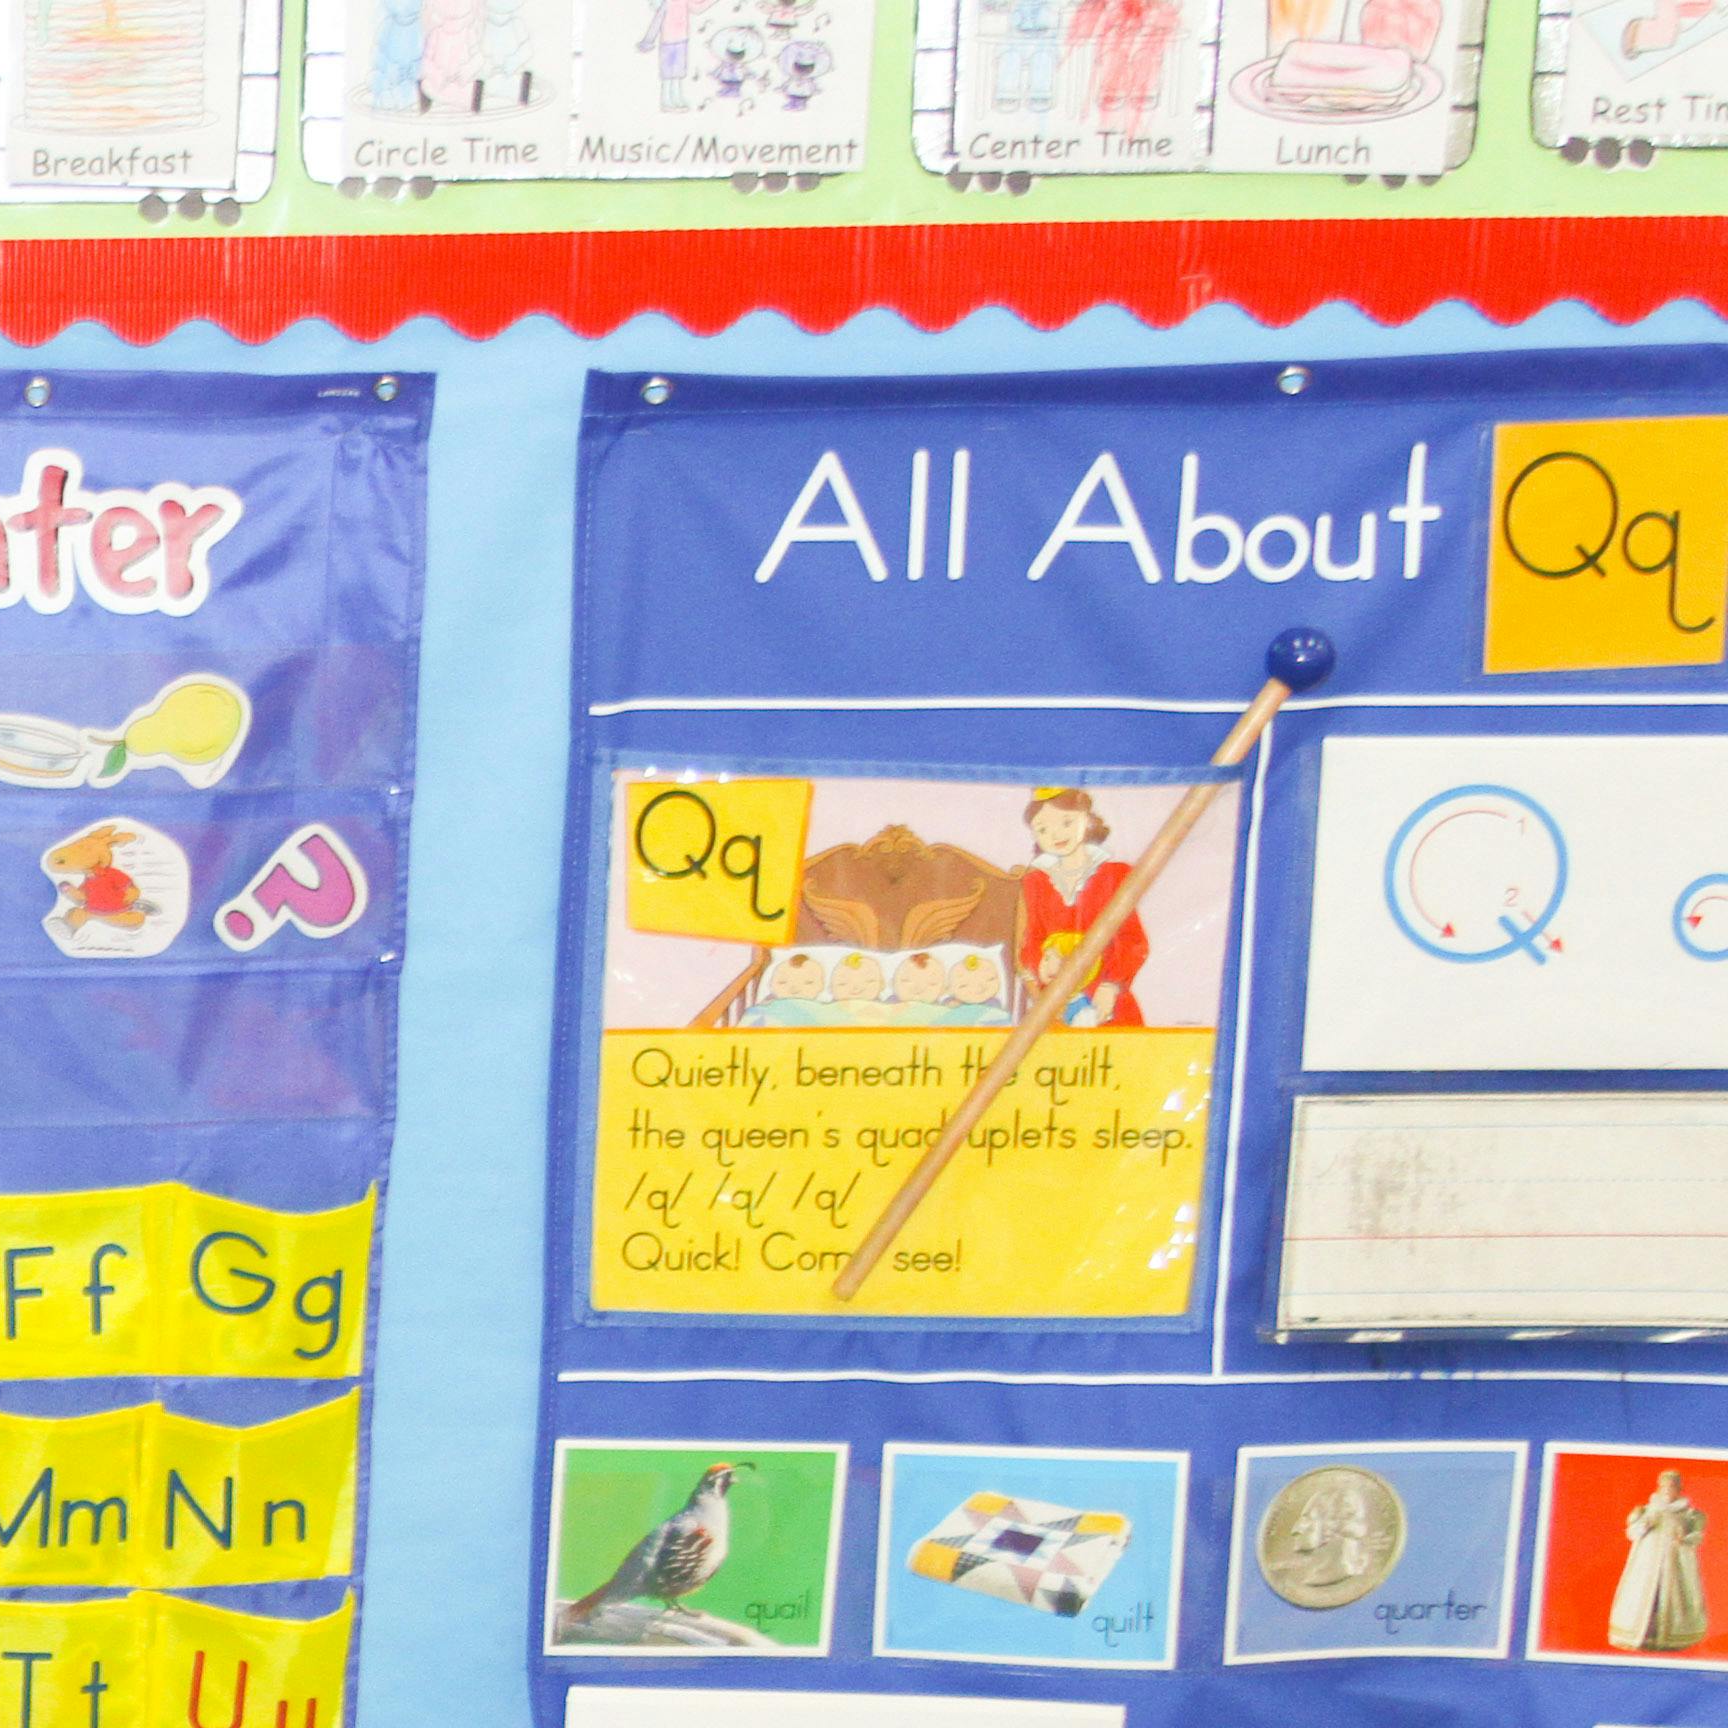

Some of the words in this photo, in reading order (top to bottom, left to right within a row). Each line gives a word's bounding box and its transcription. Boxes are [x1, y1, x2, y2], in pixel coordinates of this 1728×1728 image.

[1592, 96, 1666, 125] Rest
[32, 148, 194, 177] Breakfast
[355, 136, 449, 168] Circle
[462, 138, 541, 164] Time
[578, 135, 859, 166] Music/Movement
[970, 132, 1076, 161] Center
[1096, 132, 1174, 158] Time
[1276, 136, 1372, 166] Lunch
[755, 448, 970, 583] All
[1028, 444, 1442, 584] About
[1503, 451, 1715, 633] Qq
[635, 789, 785, 920] Qq
[631, 1046, 778, 1106] Quietly,
[796, 1045, 943, 1088] beneath
[1034, 1044, 1121, 1106] quilt,
[628, 1109, 685, 1149] the
[701, 1110, 840, 1167] queen's
[856, 1107, 1077, 1167] quaduplets
[1093, 1108, 1193, 1168] sleep.
[624, 1171, 694, 1229] /q/
[793, 1171, 861, 1229] /q/
[622, 1232, 742, 1273] Quick!
[760, 1231, 856, 1273] Com
[893, 1238, 962, 1273] see!
[2, 1243, 127, 1341] Ff
[189, 1232, 344, 1360] Gg
[164, 1469, 306, 1549] Nn
[744, 1592, 811, 1638] quail
[1091, 1598, 1154, 1648] quilt
[1374, 1590, 1488, 1636] quarter
